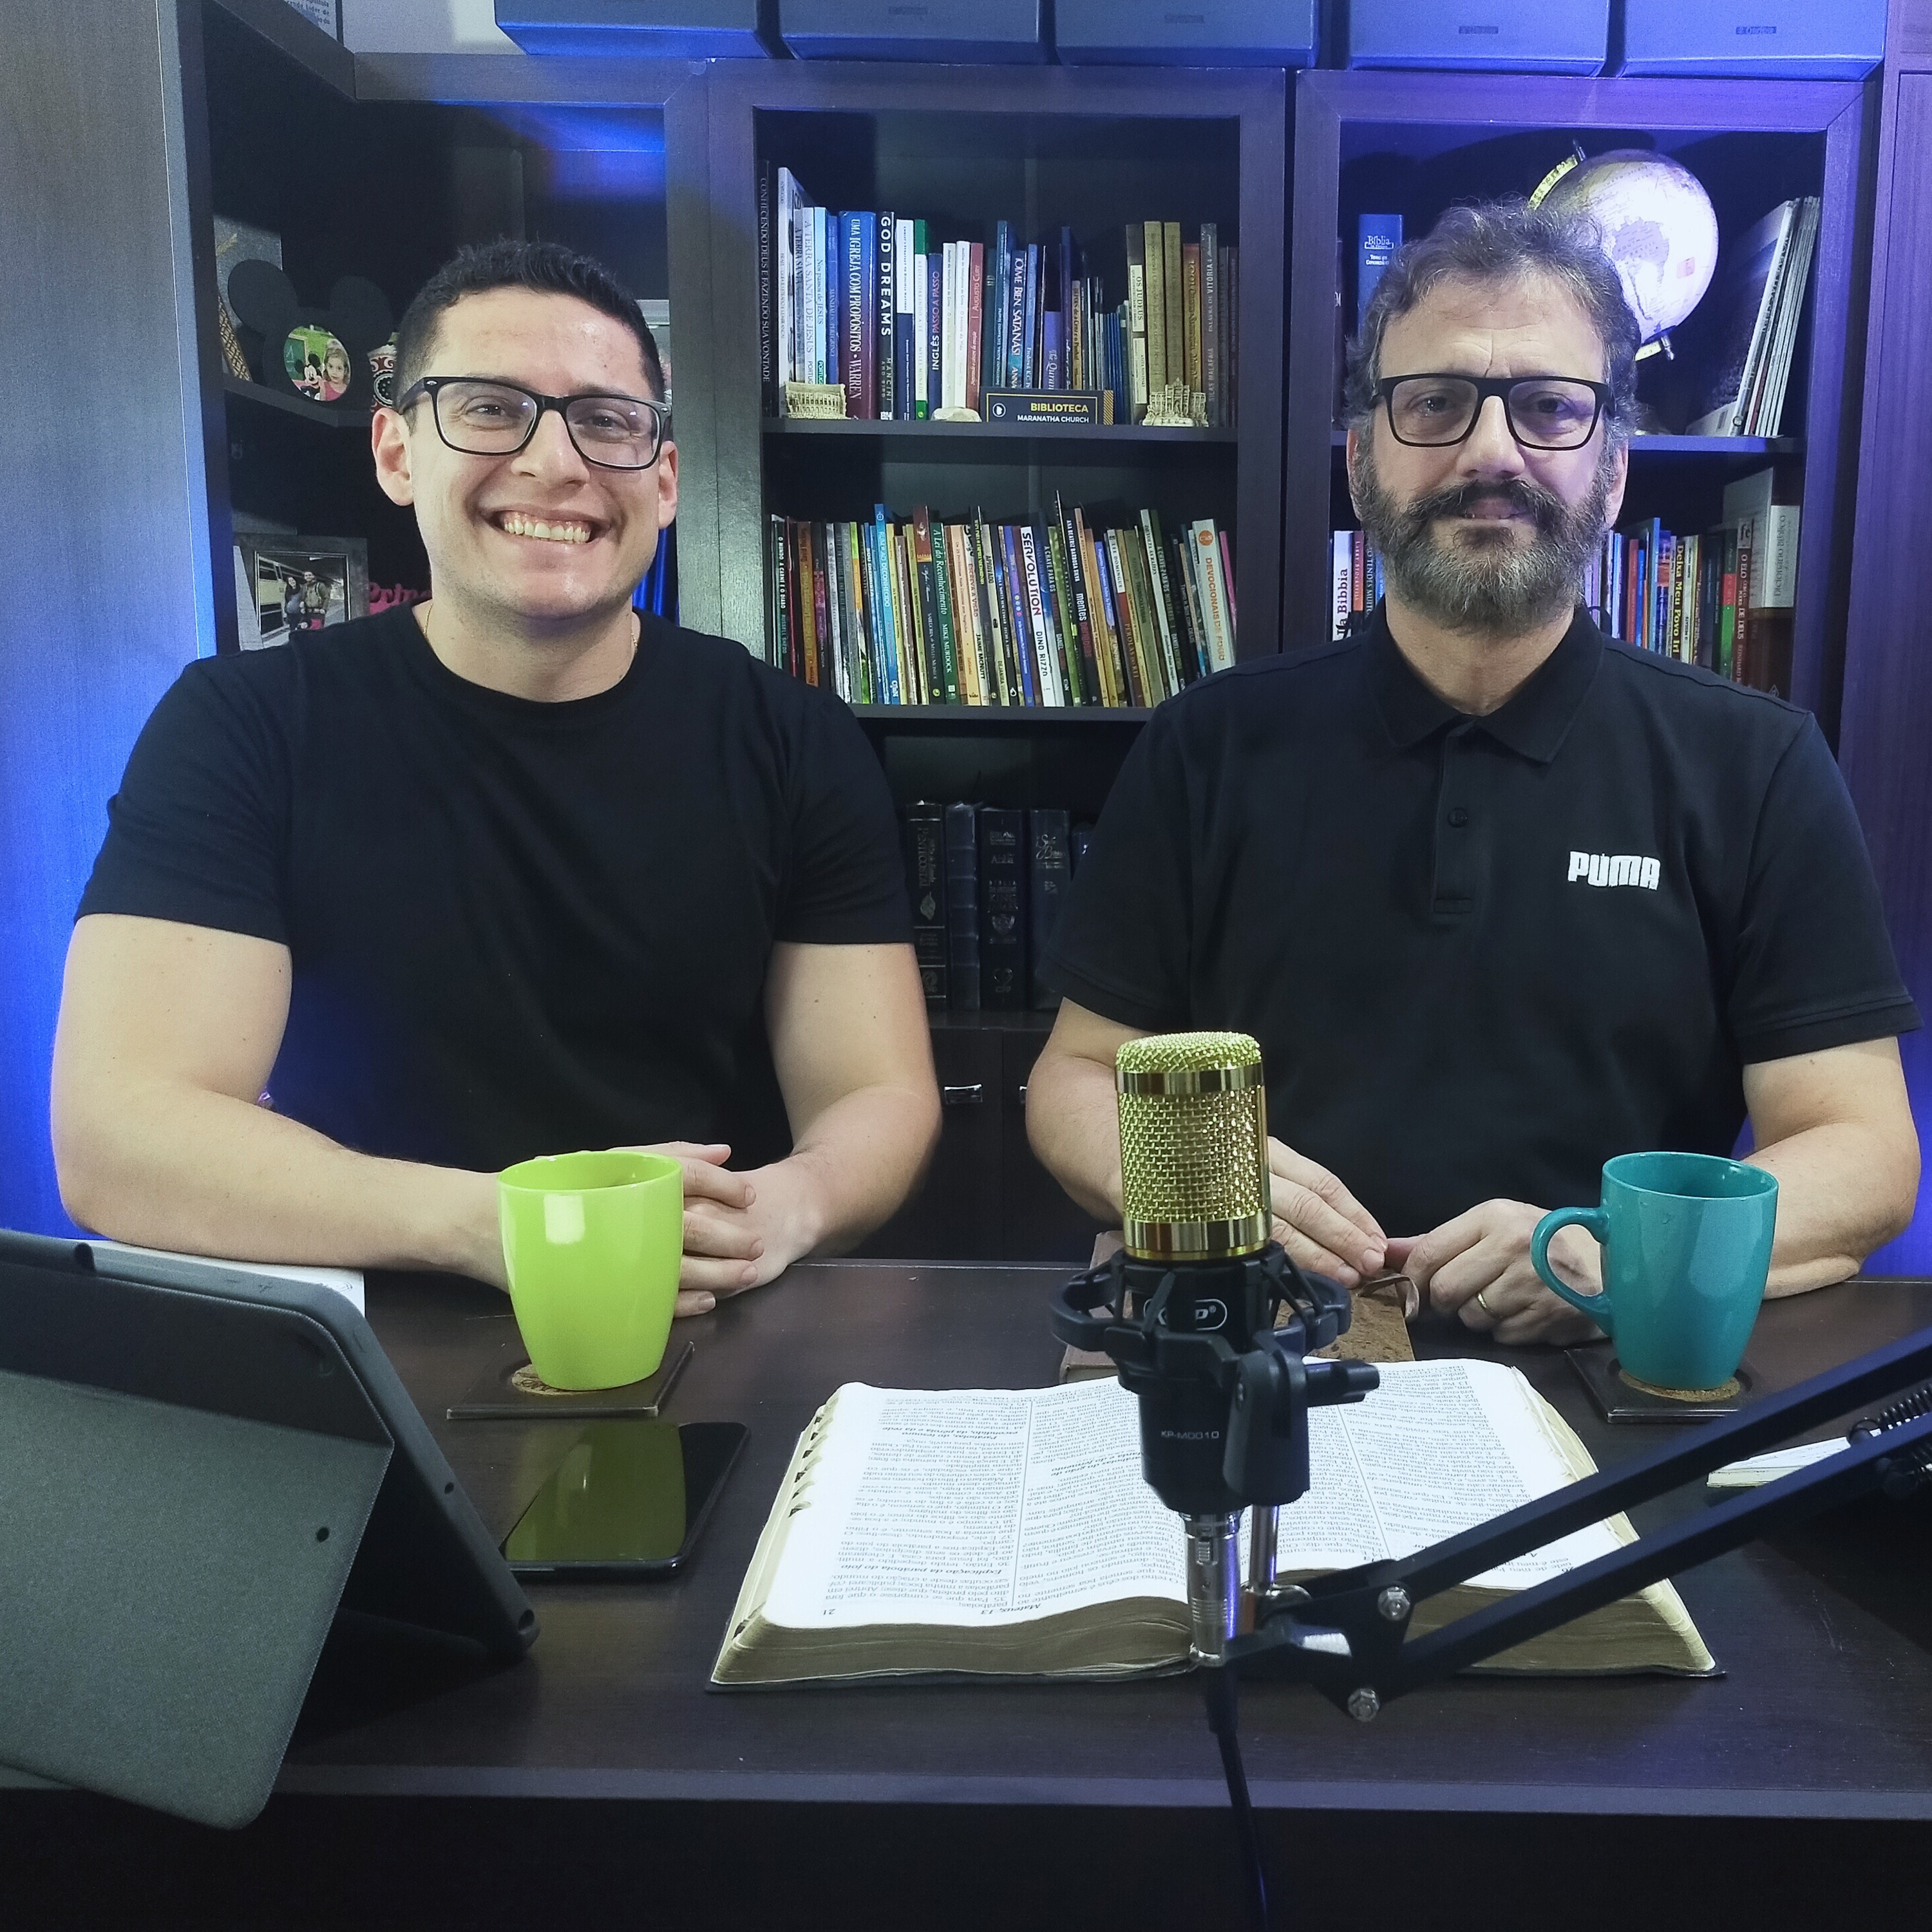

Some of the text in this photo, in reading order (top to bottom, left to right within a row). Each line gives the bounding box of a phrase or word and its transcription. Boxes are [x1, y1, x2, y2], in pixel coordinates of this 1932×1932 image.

[880, 216, 891, 336] GOD DREAMS
[1135, 276, 1142, 286] OS
[761, 277, 769, 319] FAZENDO
[849, 218, 864, 399] UMA IGREJA COM PROPÓSITOS WARREN
[806, 308, 812, 321] DE
[931, 335, 940, 370] INGLÊS
[1045, 361, 1056, 390] Quran
[1031, 403, 1089, 413] BIBLIOTECA
[934, 537, 942, 548] Lei
[1067, 529, 1075, 547] BEATRIZ
[935, 549, 943, 558] do
[1070, 548, 1078, 569] BARBOSA
[1157, 551, 1166, 569] CHAVE
[985, 554, 994, 583] APROVADO
[1022, 532, 1041, 616] SERVOLUTION
[1113, 556, 1123, 588] DOMINGUE
[936, 560, 948, 614] Reconhecimento
[1205, 557, 1220, 620] DEVOCIONAIS
[1337, 569, 1347, 613] Bibbia
[1674, 581, 1682, 604] Meu
[1075, 592, 1087, 621] mentes
[1738, 608, 1745, 618] DE
[943, 641, 952, 672] MURDOCK
[1035, 630, 1048, 676] DINO RIZZO
[1567, 851, 1661, 891] PUMA
[998, 1603, 1041, 1615] Mateus,
